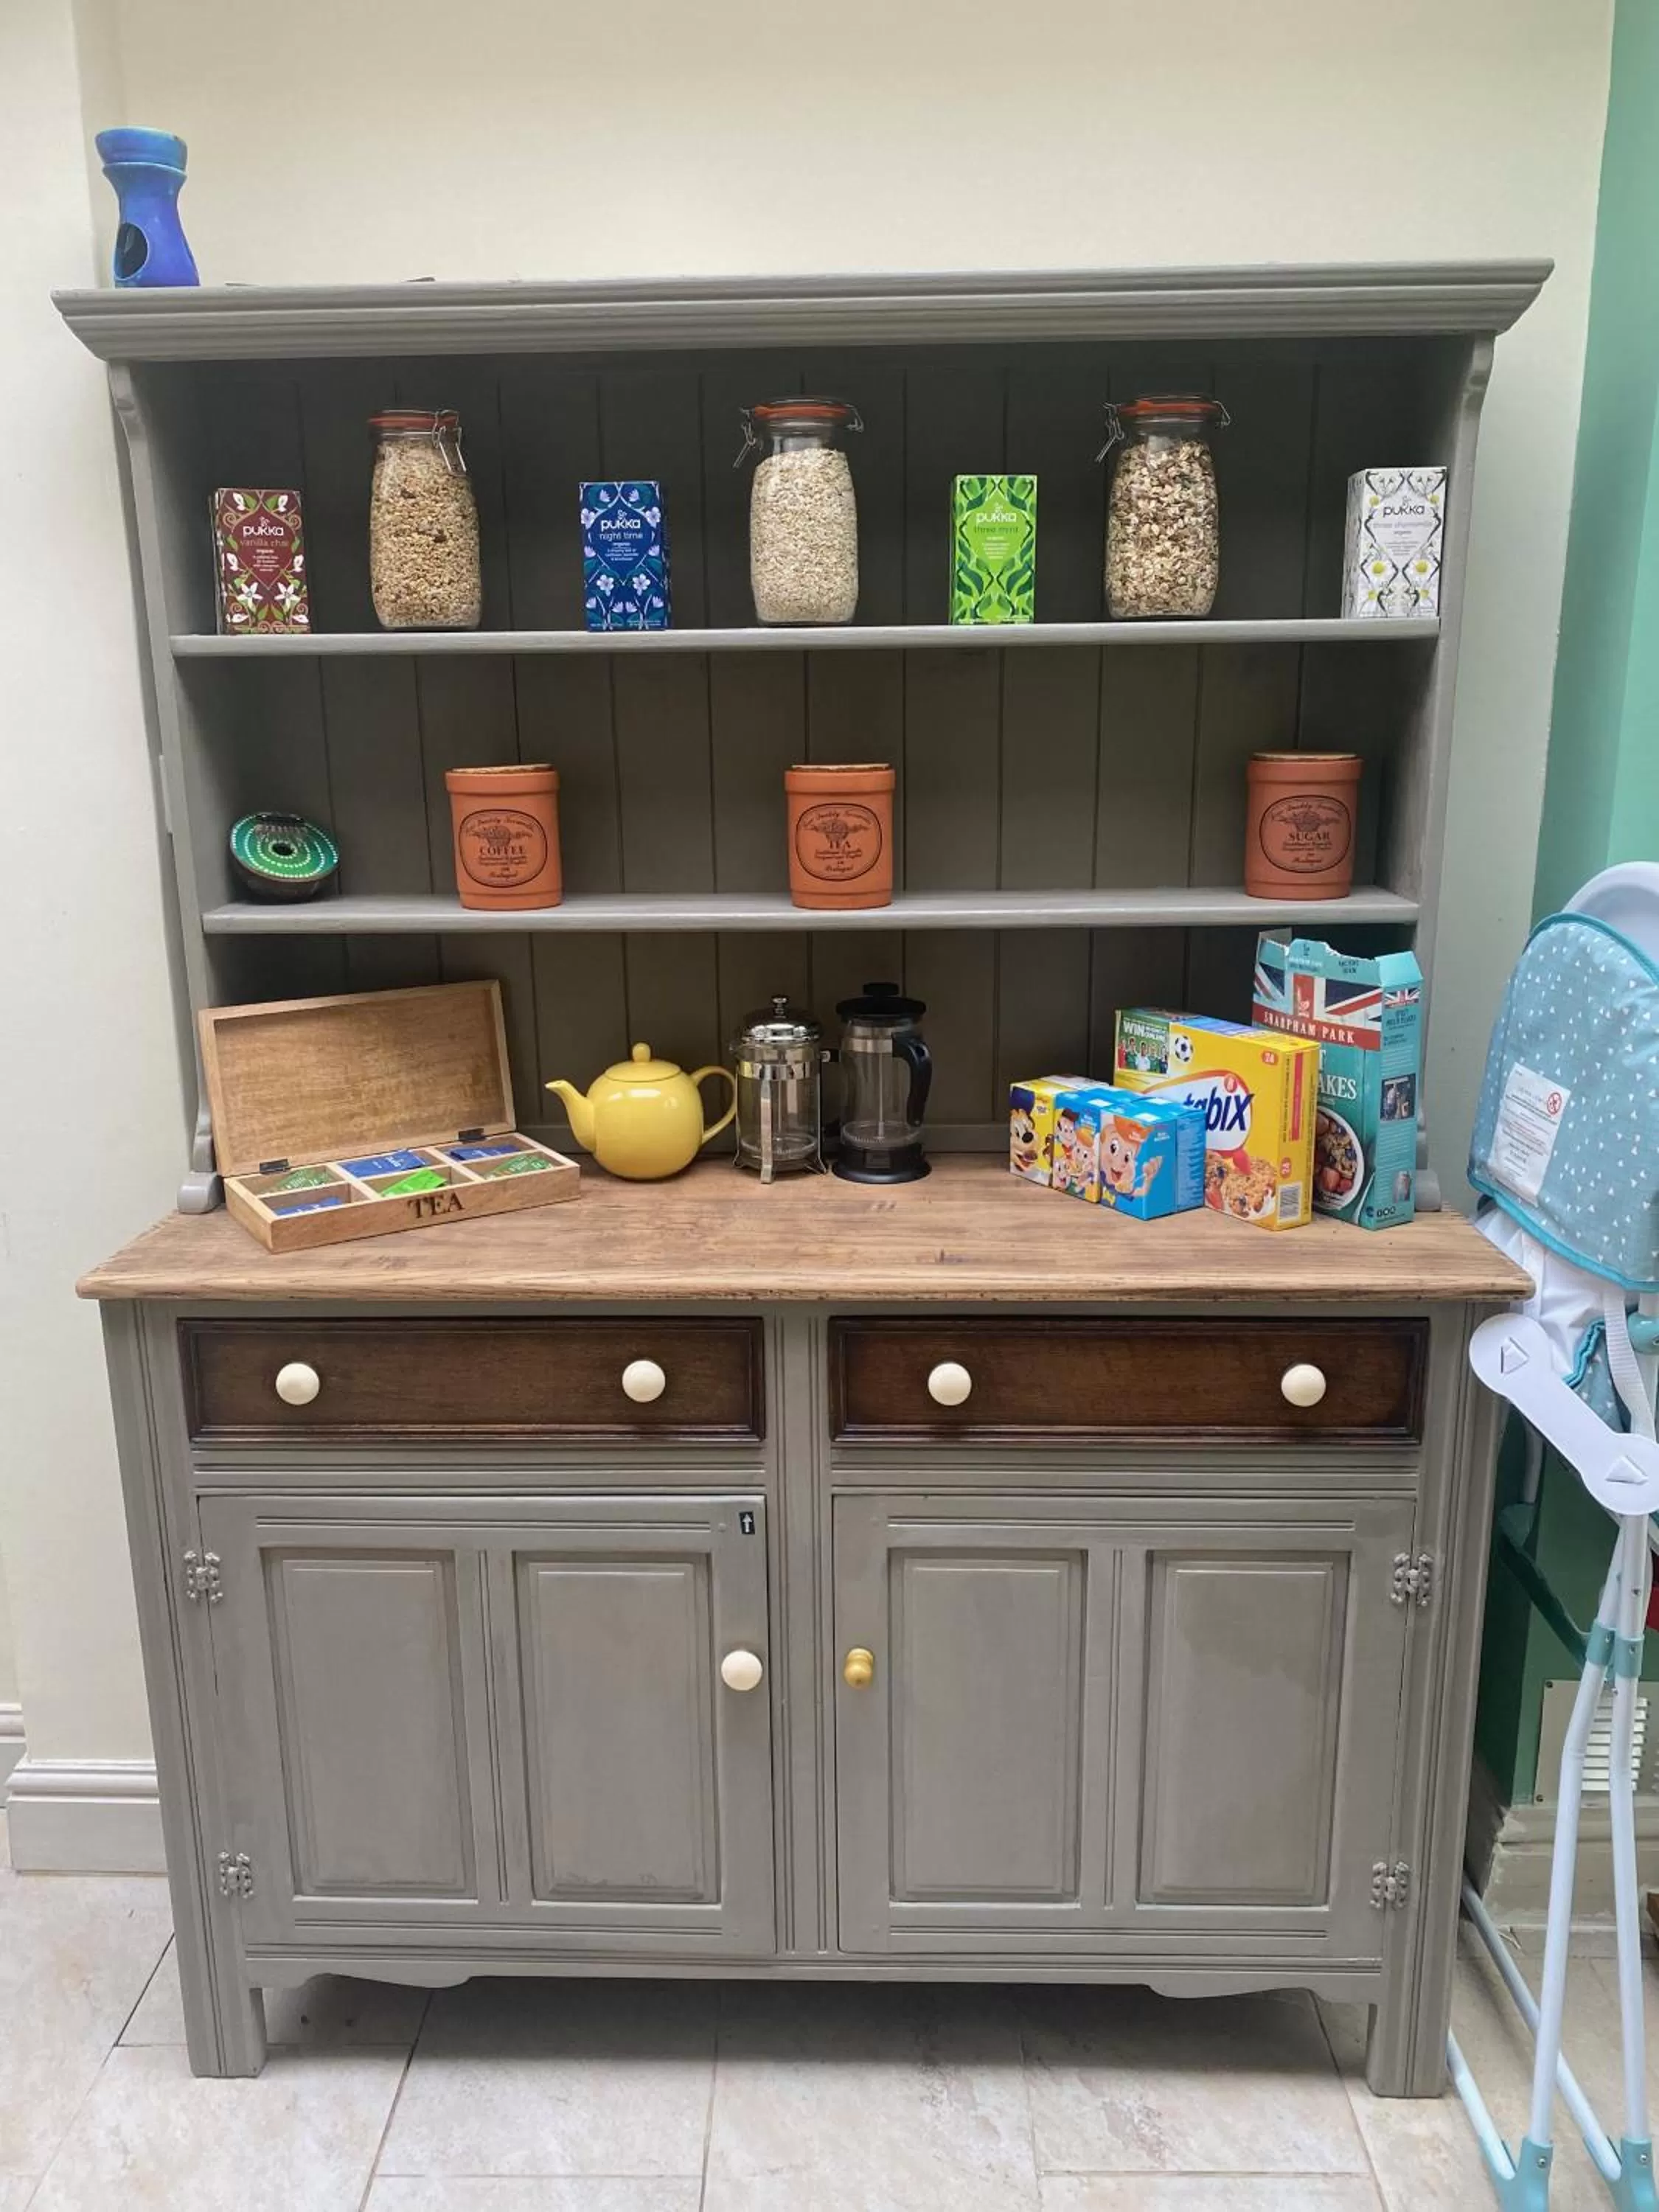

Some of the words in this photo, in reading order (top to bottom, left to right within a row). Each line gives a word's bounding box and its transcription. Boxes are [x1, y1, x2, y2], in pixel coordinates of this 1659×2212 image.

[1383, 505, 1425, 517] pukka
[601, 519, 641, 532] pukka
[976, 513, 1017, 526] pukka
[243, 526, 284, 537] pukka
[1288, 832, 1330, 841] SUGAR
[1123, 1020, 1145, 1038] WIN
[1264, 1011, 1316, 1037] SHARPHAM
[1322, 1026, 1355, 1043] PARK
[407, 1192, 466, 1219] TEA
